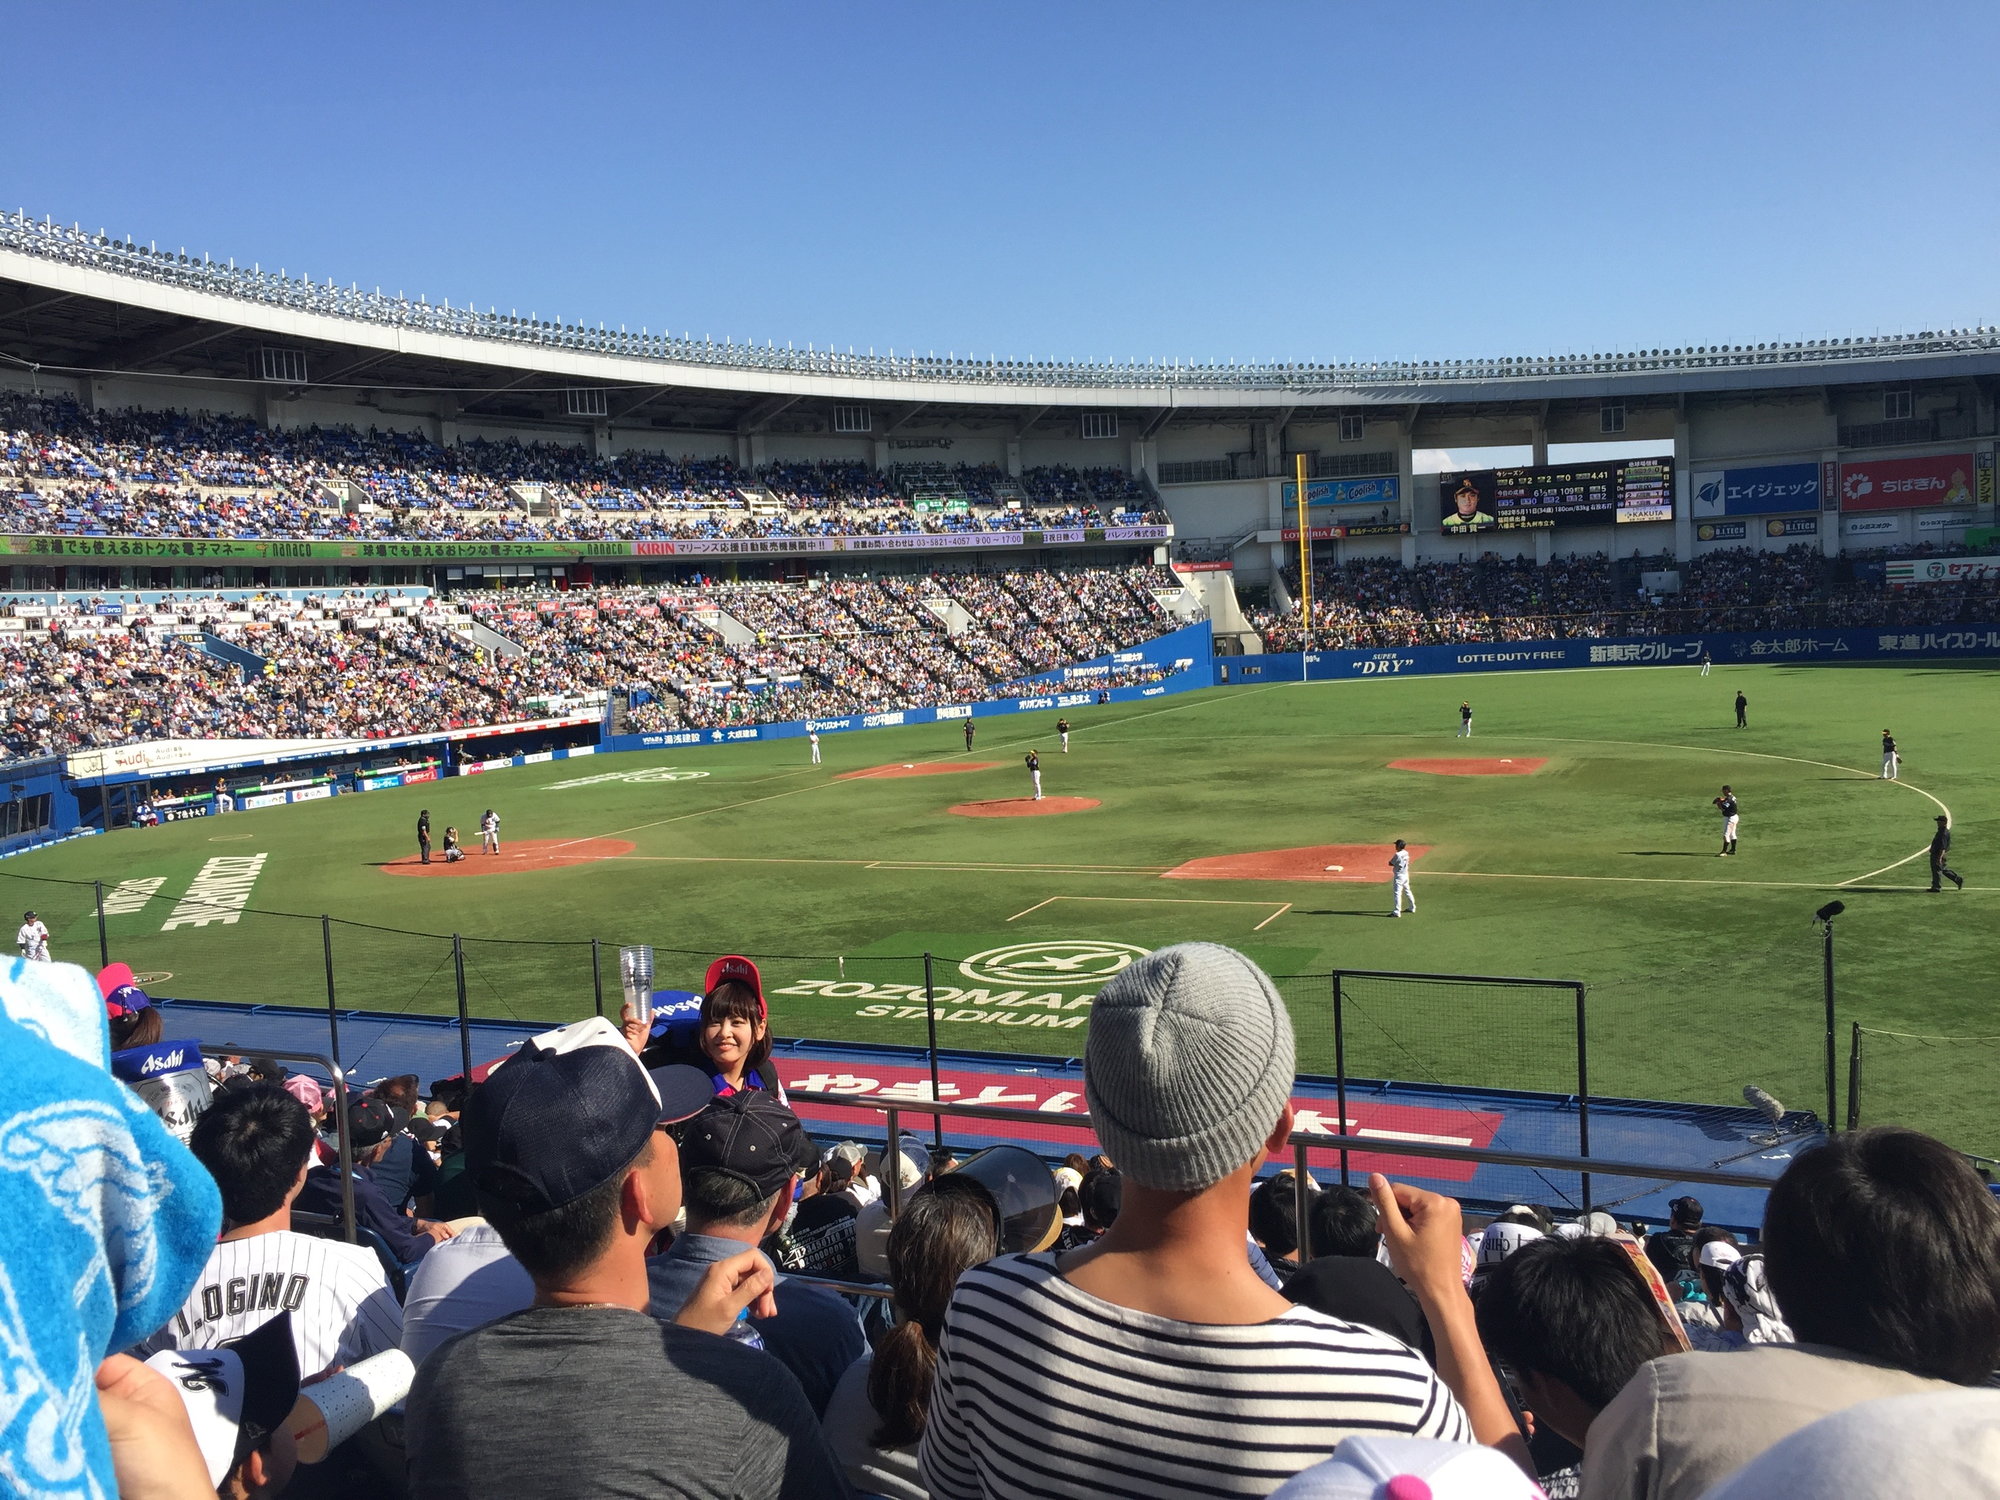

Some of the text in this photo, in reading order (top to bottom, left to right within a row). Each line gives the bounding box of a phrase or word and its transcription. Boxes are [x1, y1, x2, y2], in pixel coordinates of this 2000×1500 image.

[1349, 484, 1377, 500] Coolish
[1727, 480, 1817, 499] エイジェック
[1881, 476, 1946, 493] ちばぎん
[1979, 468, 1992, 503] エクシオ
[1284, 530, 1328, 540] LOTRIA
[1450, 525, 1467, 533] 中田
[33, 539, 312, 557] 球場でも使えるおトクな電子マネー nanaco
[363, 542, 624, 557] 球場でも使えるおトクな電子マネー nanaco
[636, 542, 675, 555] KIRIN
[916, 537, 970, 548] 03-5821-4057
[1001, 534, 1022, 544] 17:00
[1589, 641, 1703, 663] 新東京グループ
[1749, 639, 1849, 656] 金太郎ホーム
[1457, 650, 1565, 664] LOTTE DUTY FREE
[814, 719, 850, 731] アイリスオーヤマ
[664, 733, 700, 745] 湯浅建設
[770, 979, 1096, 1011] ZOZOMAR
[652, 995, 702, 1017] Asah
[855, 1004, 1088, 1029] STADIUM
[141, 1048, 184, 1075] Asahi
[157, 1098, 204, 1130] sahi
